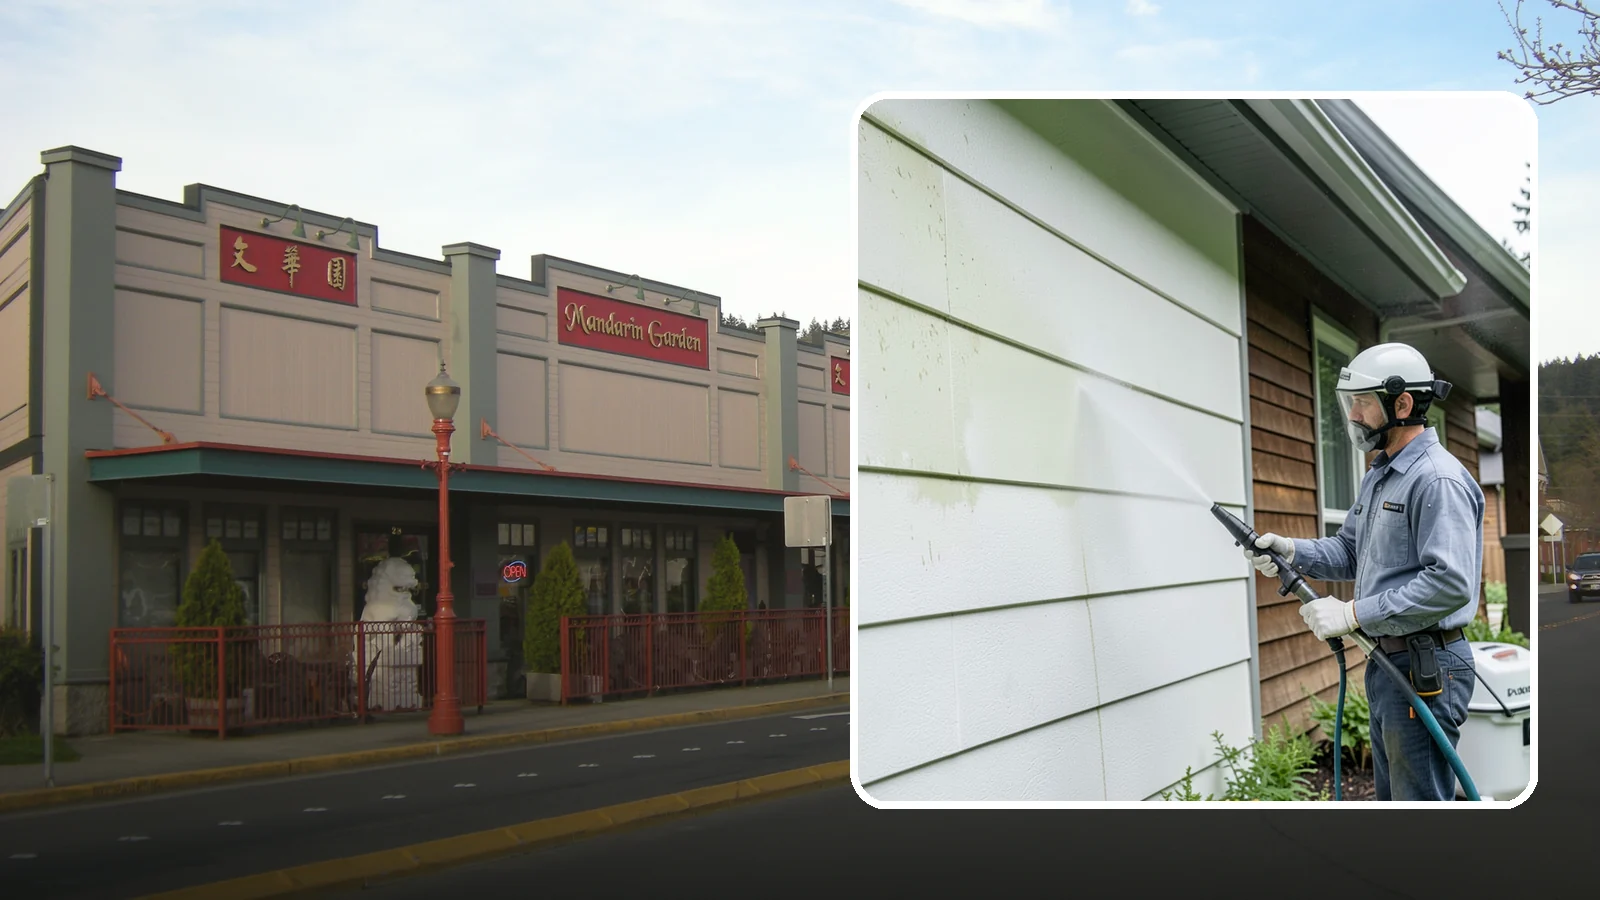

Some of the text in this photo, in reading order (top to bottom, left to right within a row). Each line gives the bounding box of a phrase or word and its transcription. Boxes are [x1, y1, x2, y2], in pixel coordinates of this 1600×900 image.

[230, 235, 346, 292] 文華園
[564, 302, 702, 352] Mandarin Garden
[503, 565, 527, 578] OPEN
